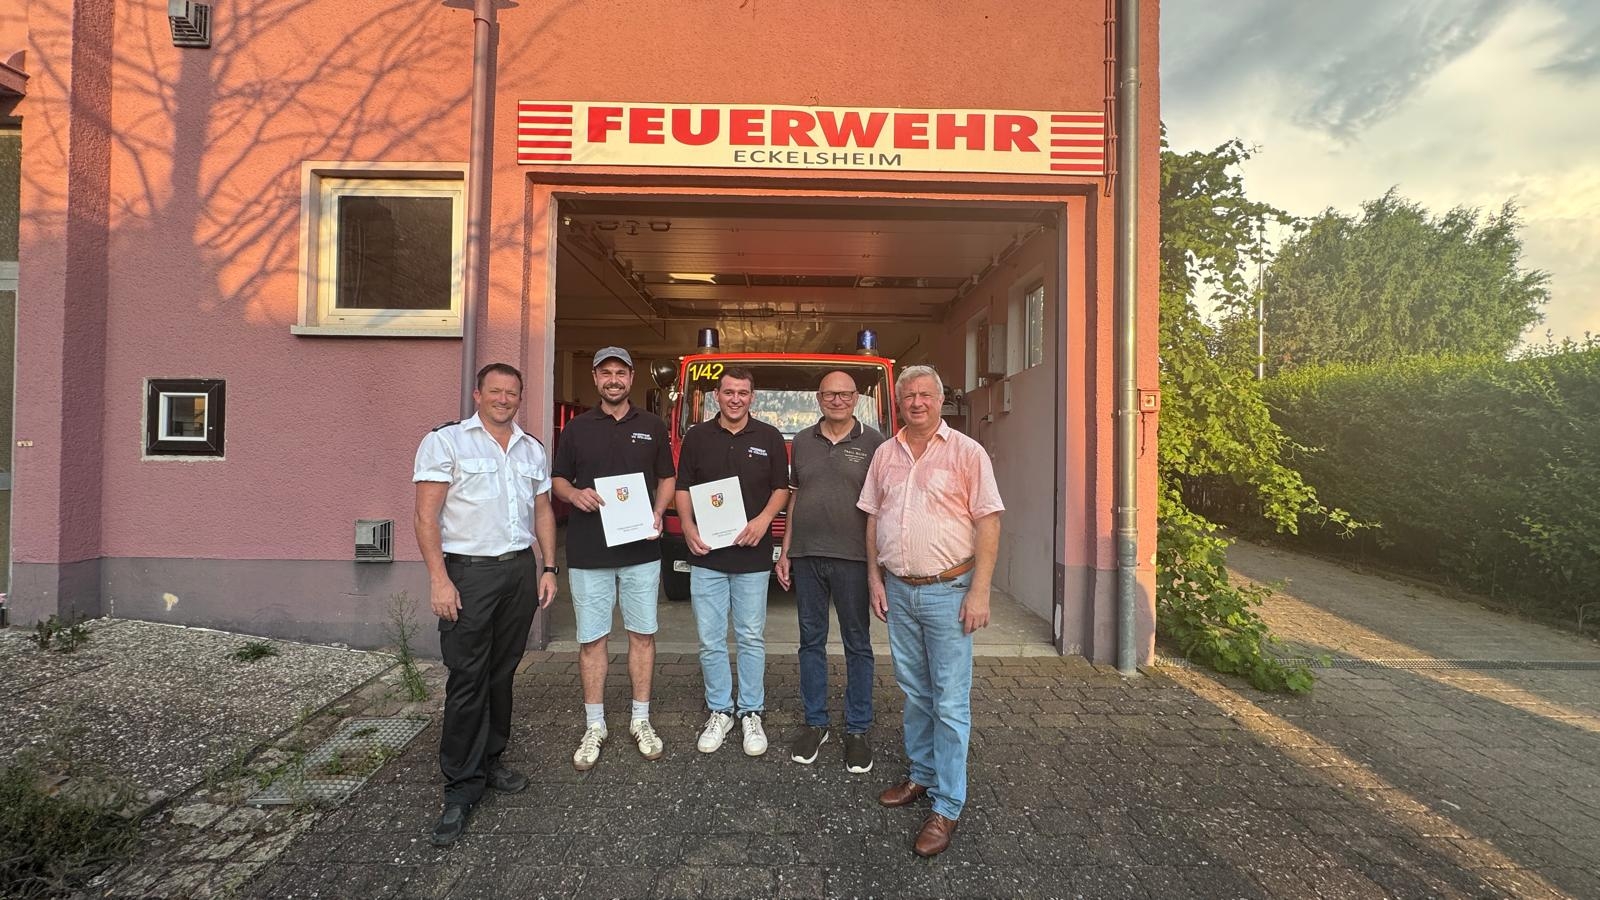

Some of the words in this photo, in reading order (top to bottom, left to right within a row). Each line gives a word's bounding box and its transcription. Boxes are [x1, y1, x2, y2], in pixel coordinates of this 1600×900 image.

[587, 106, 1041, 152] FEUERWEHR
[734, 150, 901, 166] ECKELSHEIM
[690, 363, 724, 380] 1/42
